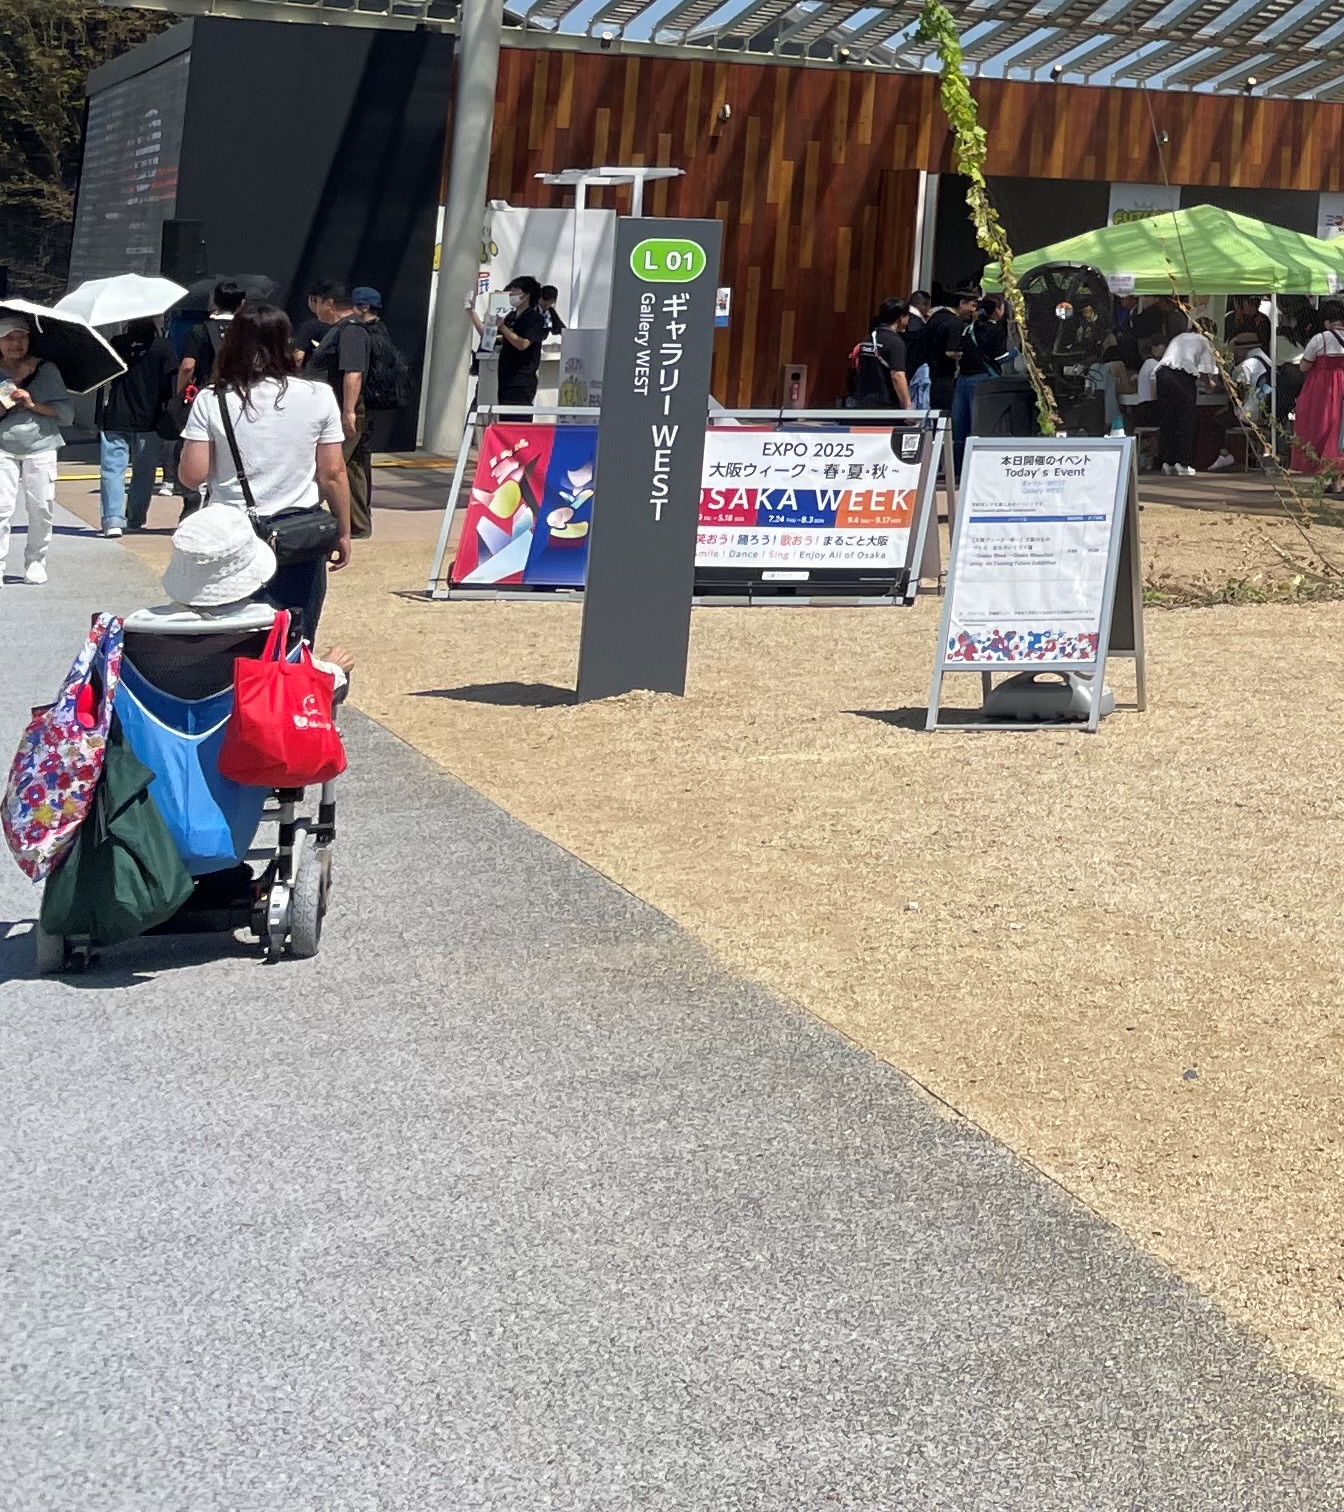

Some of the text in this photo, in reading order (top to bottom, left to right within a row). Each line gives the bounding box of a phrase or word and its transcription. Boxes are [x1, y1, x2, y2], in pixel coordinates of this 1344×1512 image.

[643, 250, 694, 272] L 01
[633, 292, 656, 397] Gallery WEST
[650, 292, 690, 522] ギャラリー WEST
[762, 442, 855, 458] EXPO 2025
[1000, 455, 1091, 466] 本日開催のイベント
[1054, 468, 1086, 477] Event
[815, 488, 909, 511] WEEK
[857, 551, 886, 560] Osaka
